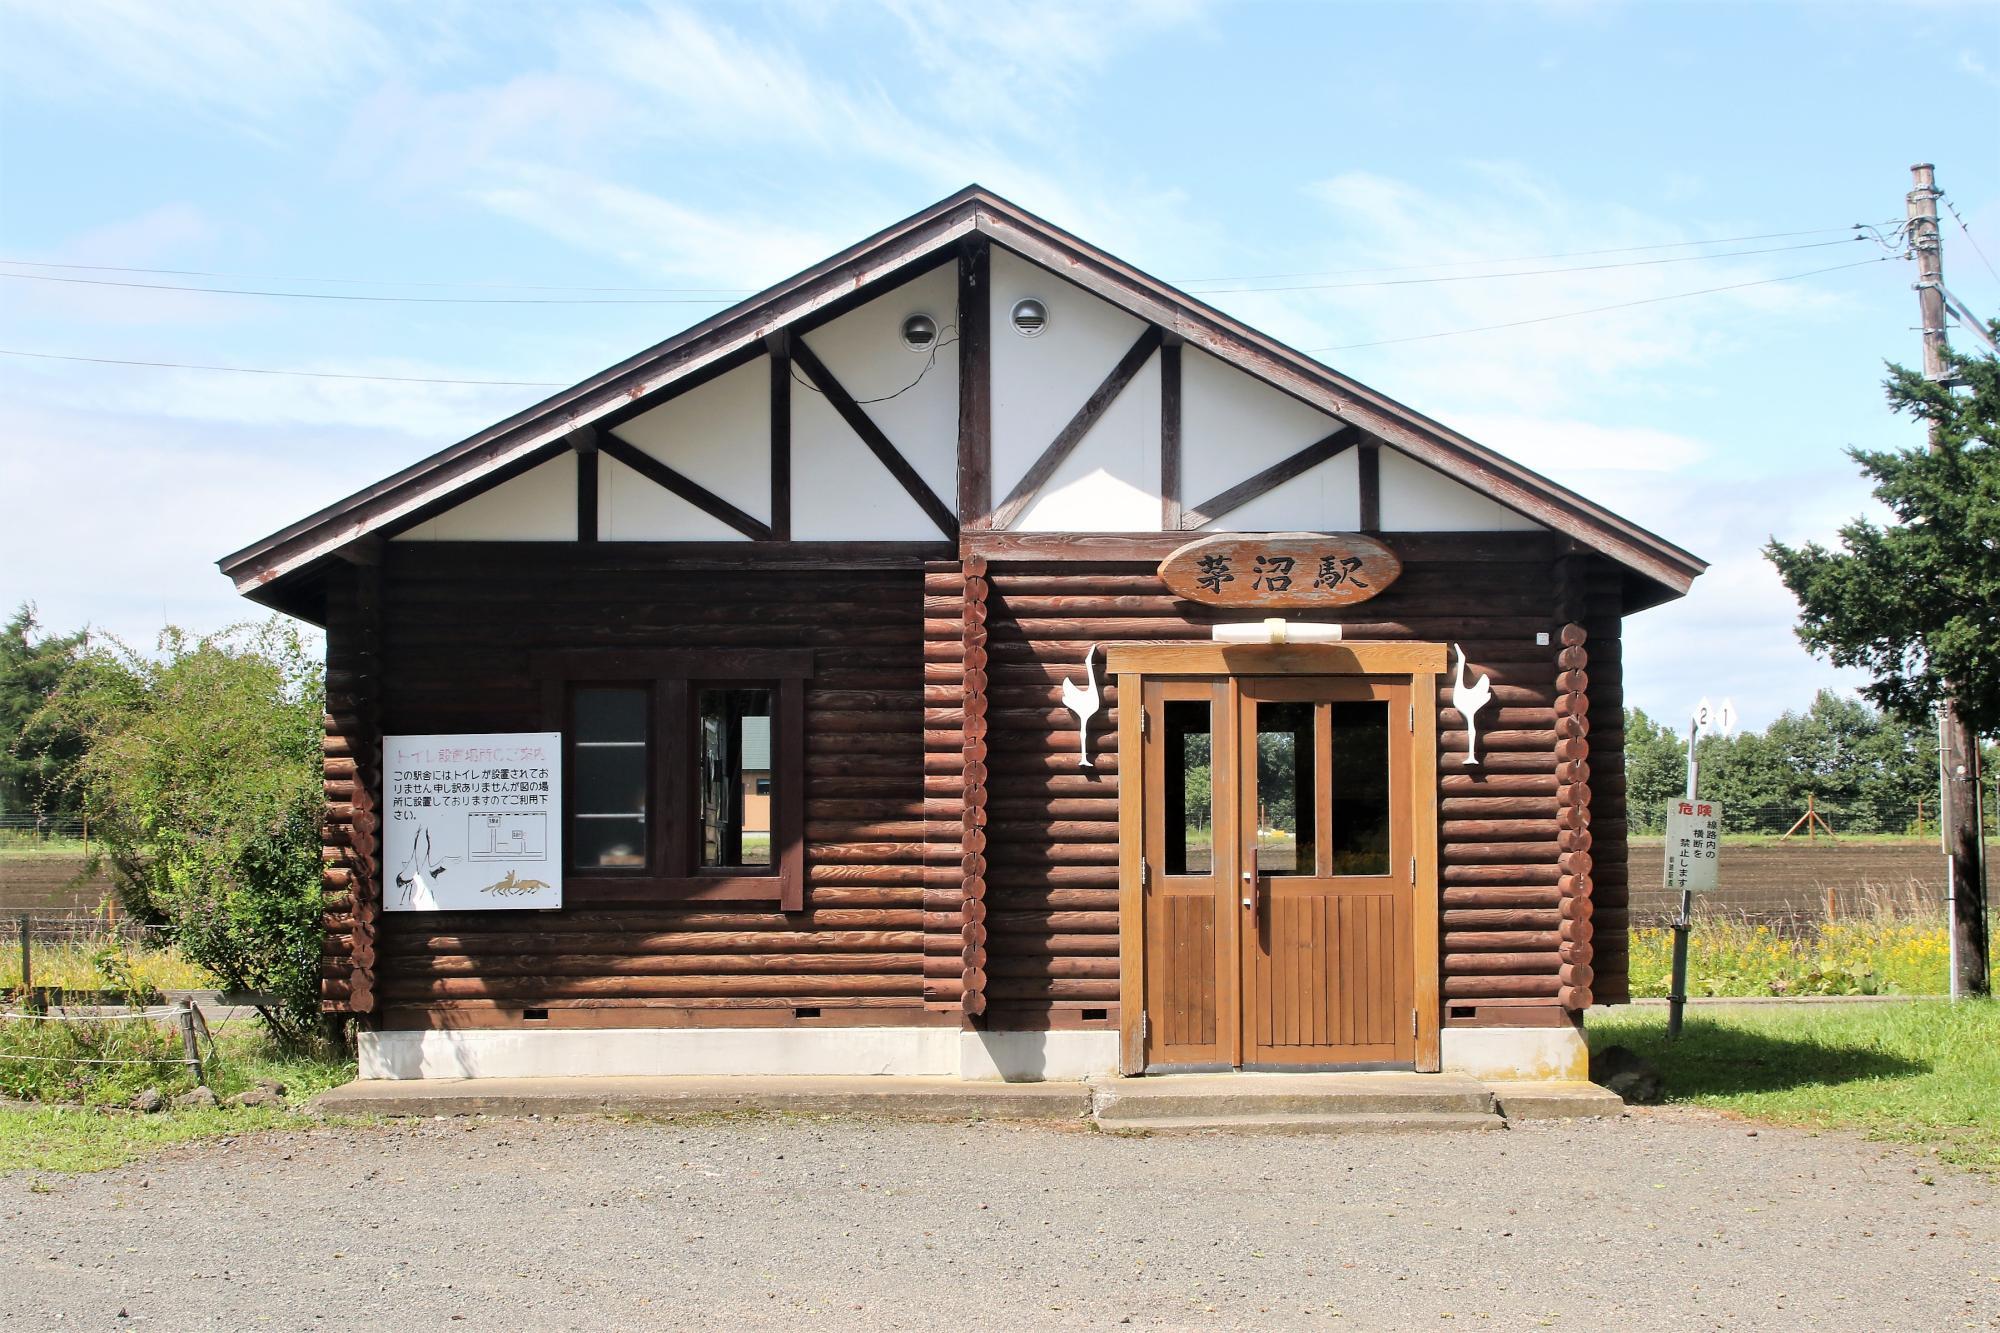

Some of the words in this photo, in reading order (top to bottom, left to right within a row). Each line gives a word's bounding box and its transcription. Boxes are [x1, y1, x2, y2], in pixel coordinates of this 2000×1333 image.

[1196, 554, 1369, 595] 茅沼駅
[1700, 707, 1708, 725] 2
[393, 794, 549, 808] 所に設置しておりますのでご利用下
[1678, 802, 1713, 817] 危険
[1693, 829, 1704, 859] 横断を
[1706, 820, 1718, 859] 線路内の
[1678, 838, 1691, 888] 禁止します
